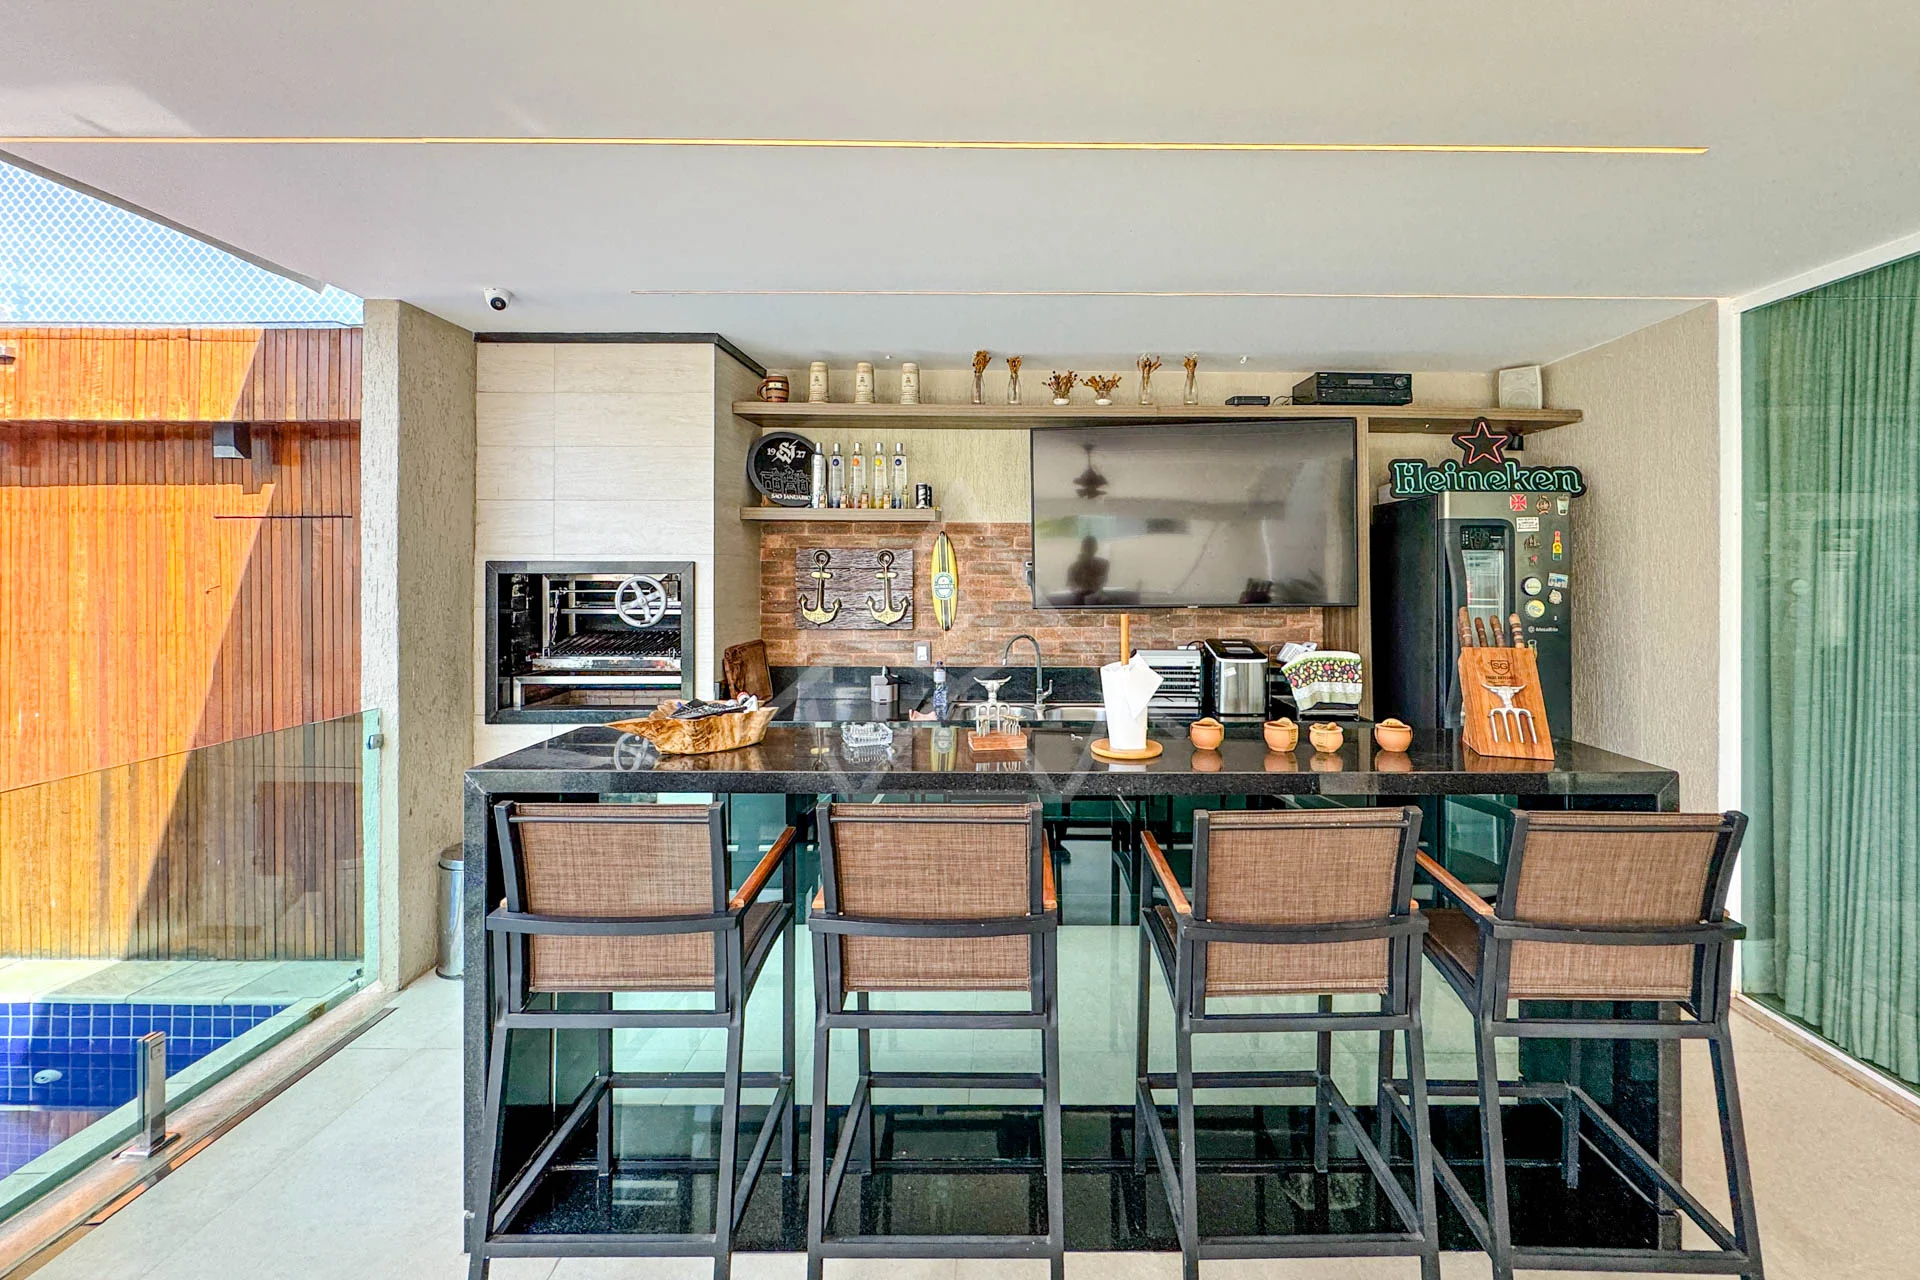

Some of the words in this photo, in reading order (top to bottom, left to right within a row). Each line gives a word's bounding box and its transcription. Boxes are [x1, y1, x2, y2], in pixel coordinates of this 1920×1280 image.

[766, 447, 776, 456] 19
[795, 450, 807, 459] 27
[1394, 462, 1582, 494] Heineken
[1492, 662, 1508, 670] SG
